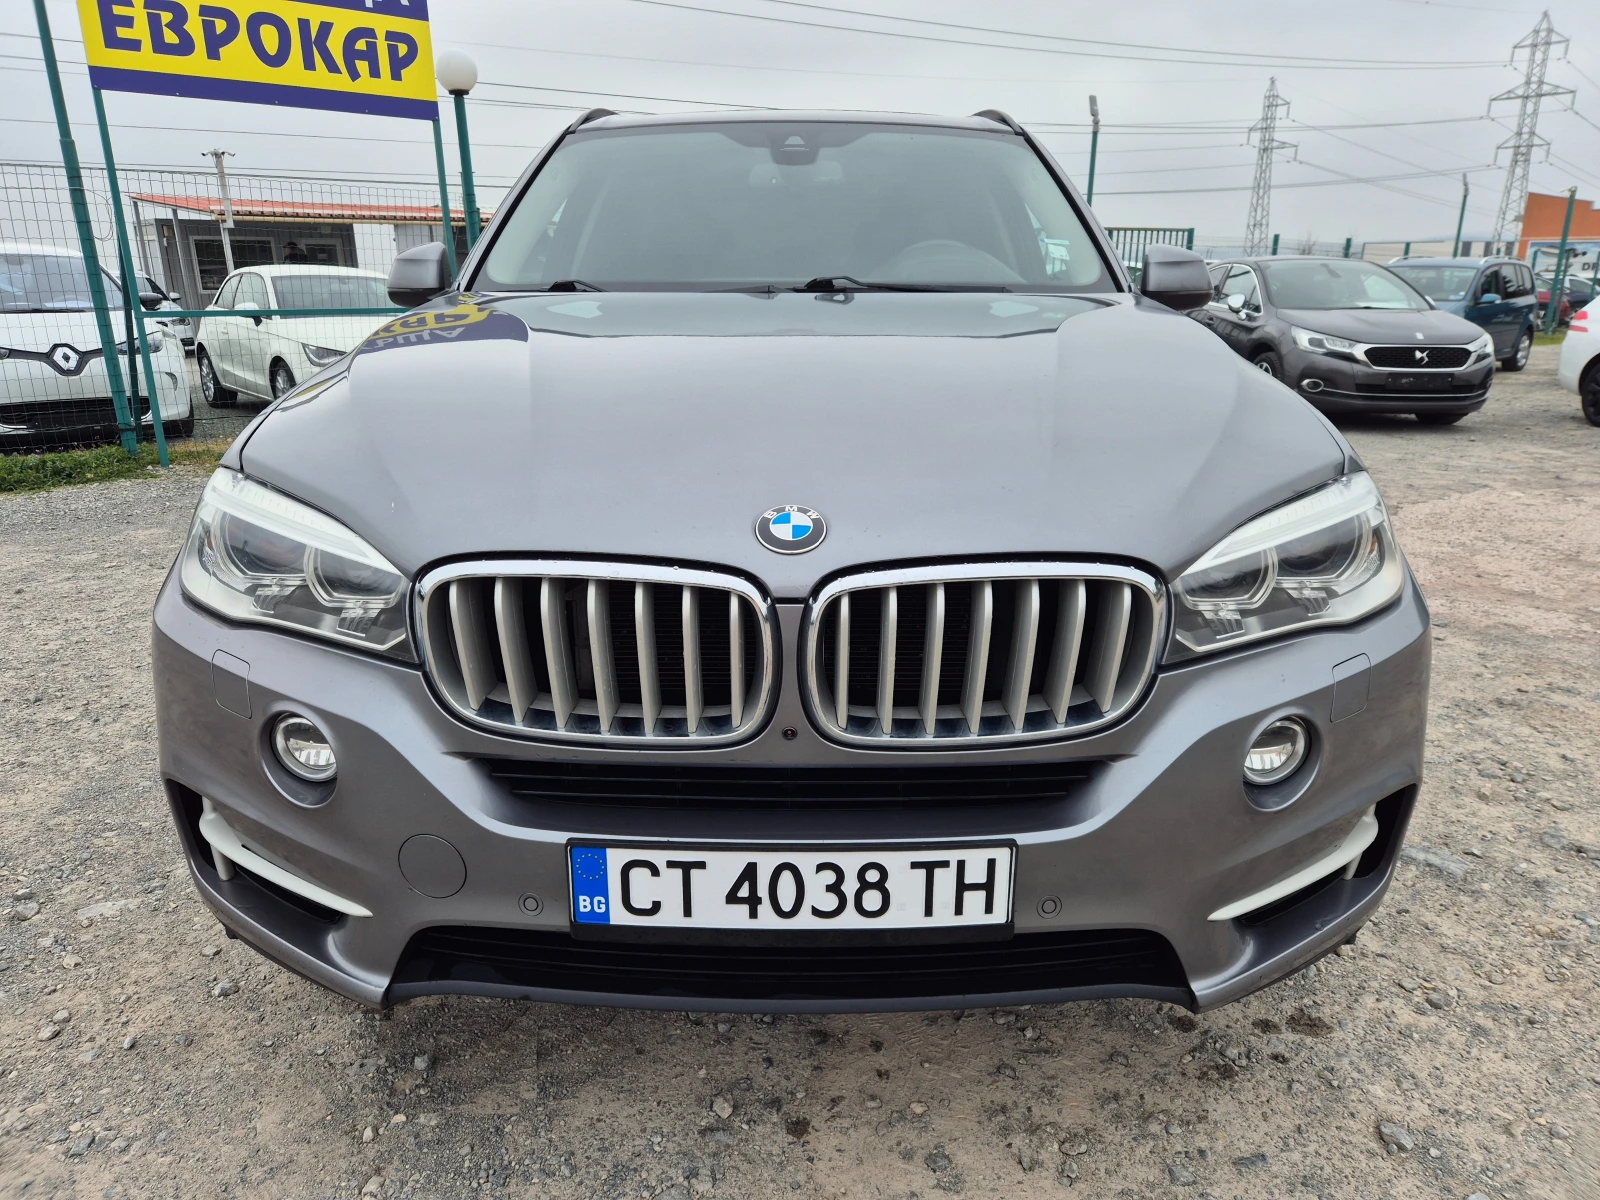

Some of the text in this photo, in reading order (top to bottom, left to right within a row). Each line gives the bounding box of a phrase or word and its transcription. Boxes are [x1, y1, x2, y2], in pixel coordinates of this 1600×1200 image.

[97, 0, 419, 83] ЕВРОКАР
[763, 505, 820, 519] BMW
[578, 895, 606, 913] BG
[620, 858, 997, 920] CT 4038 TH
